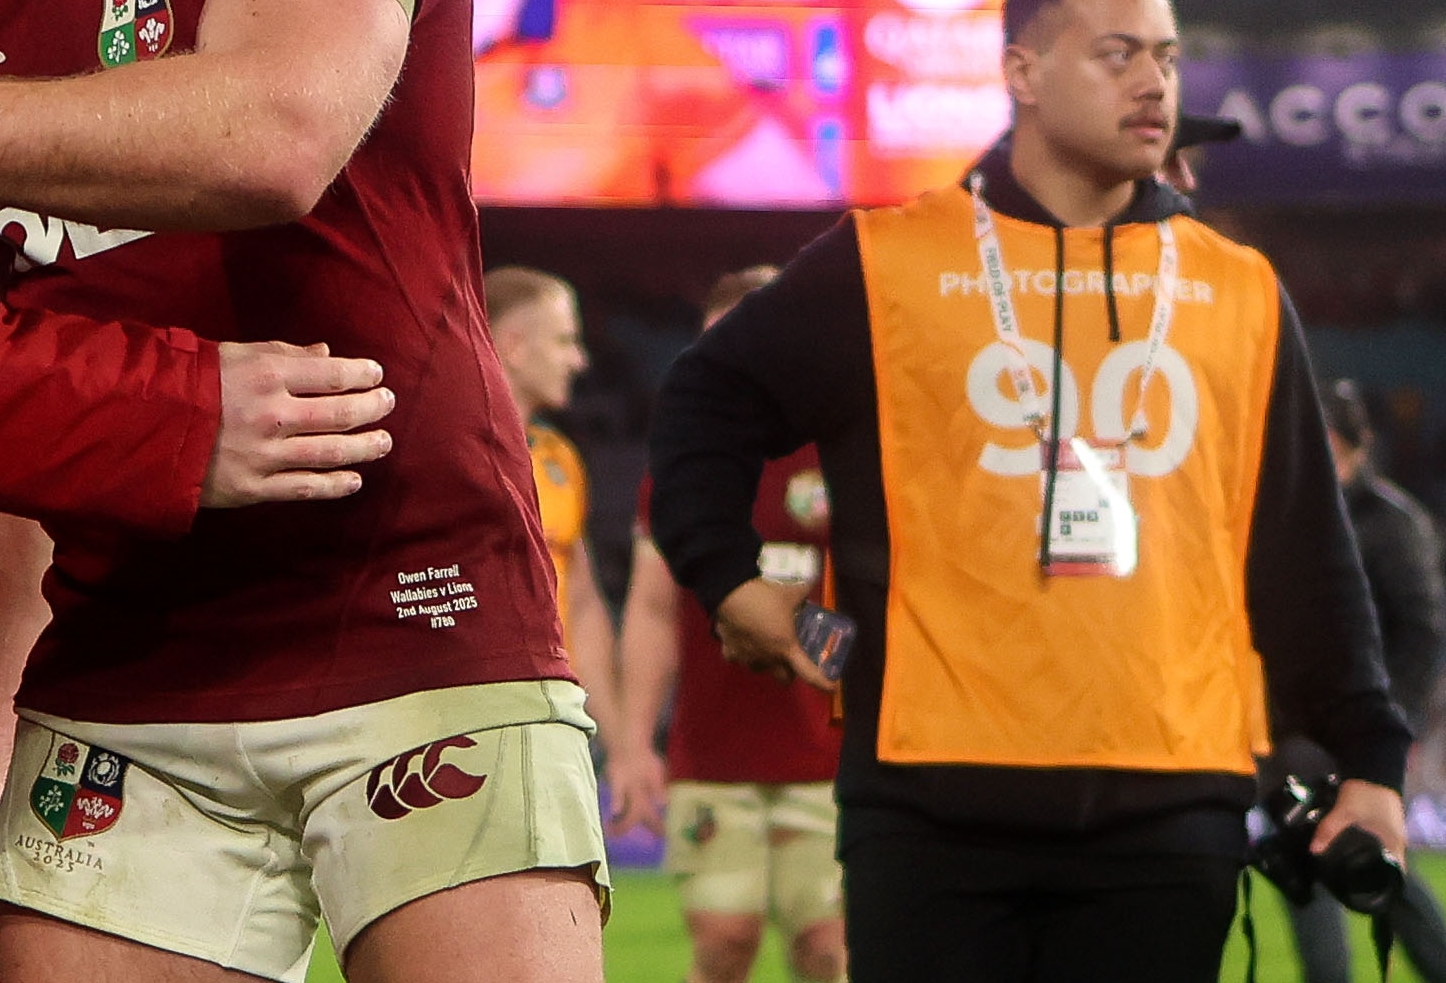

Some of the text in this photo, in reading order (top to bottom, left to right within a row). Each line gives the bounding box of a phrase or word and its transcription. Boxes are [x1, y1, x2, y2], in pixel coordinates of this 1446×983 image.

[939, 269, 1214, 305] PHTOGRAPER
[966, 338, 1199, 477] 90
[397, 563, 460, 585] Owen Farrell
[389, 581, 474, 605] Wallabies v Lions
[396, 595, 478, 619] 2nd August 2025
[14, 833, 103, 871] AUSTRALIA
[33, 851, 75, 873] 2025
